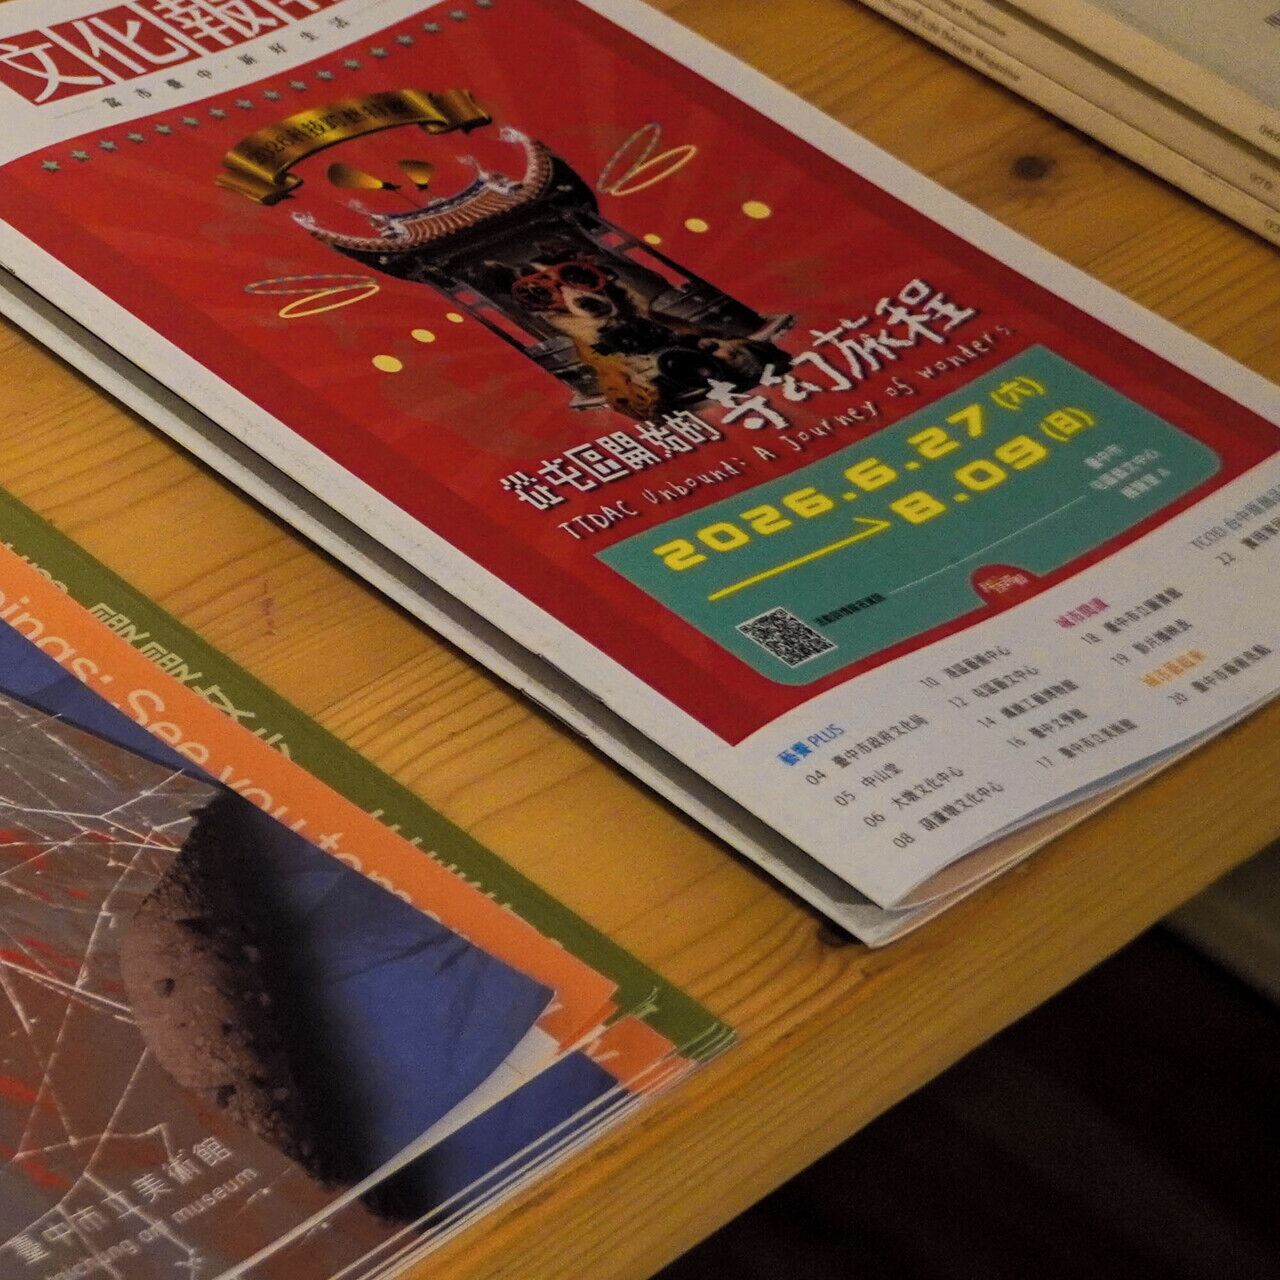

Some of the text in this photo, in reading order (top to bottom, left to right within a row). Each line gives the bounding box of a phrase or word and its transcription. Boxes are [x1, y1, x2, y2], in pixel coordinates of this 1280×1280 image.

[706, 279, 977, 431] 奇幻旅程
[558, 499, 640, 541] TTDAC
[753, 444, 774, 465] A
[778, 401, 880, 454] Journey
[886, 376, 915, 399] of
[652, 402, 989, 572] 2026.6.27
[889, 434, 1050, 526] 8.09
[804, 712, 928, 788] 04 臺中市政府文化局
[807, 722, 844, 751] PLUS
[834, 761, 905, 808] 05 中山堂
[861, 764, 965, 829] 06 大墩文化中心
[892, 829, 917, 851] 08
[170, 1165, 260, 1226] museum
